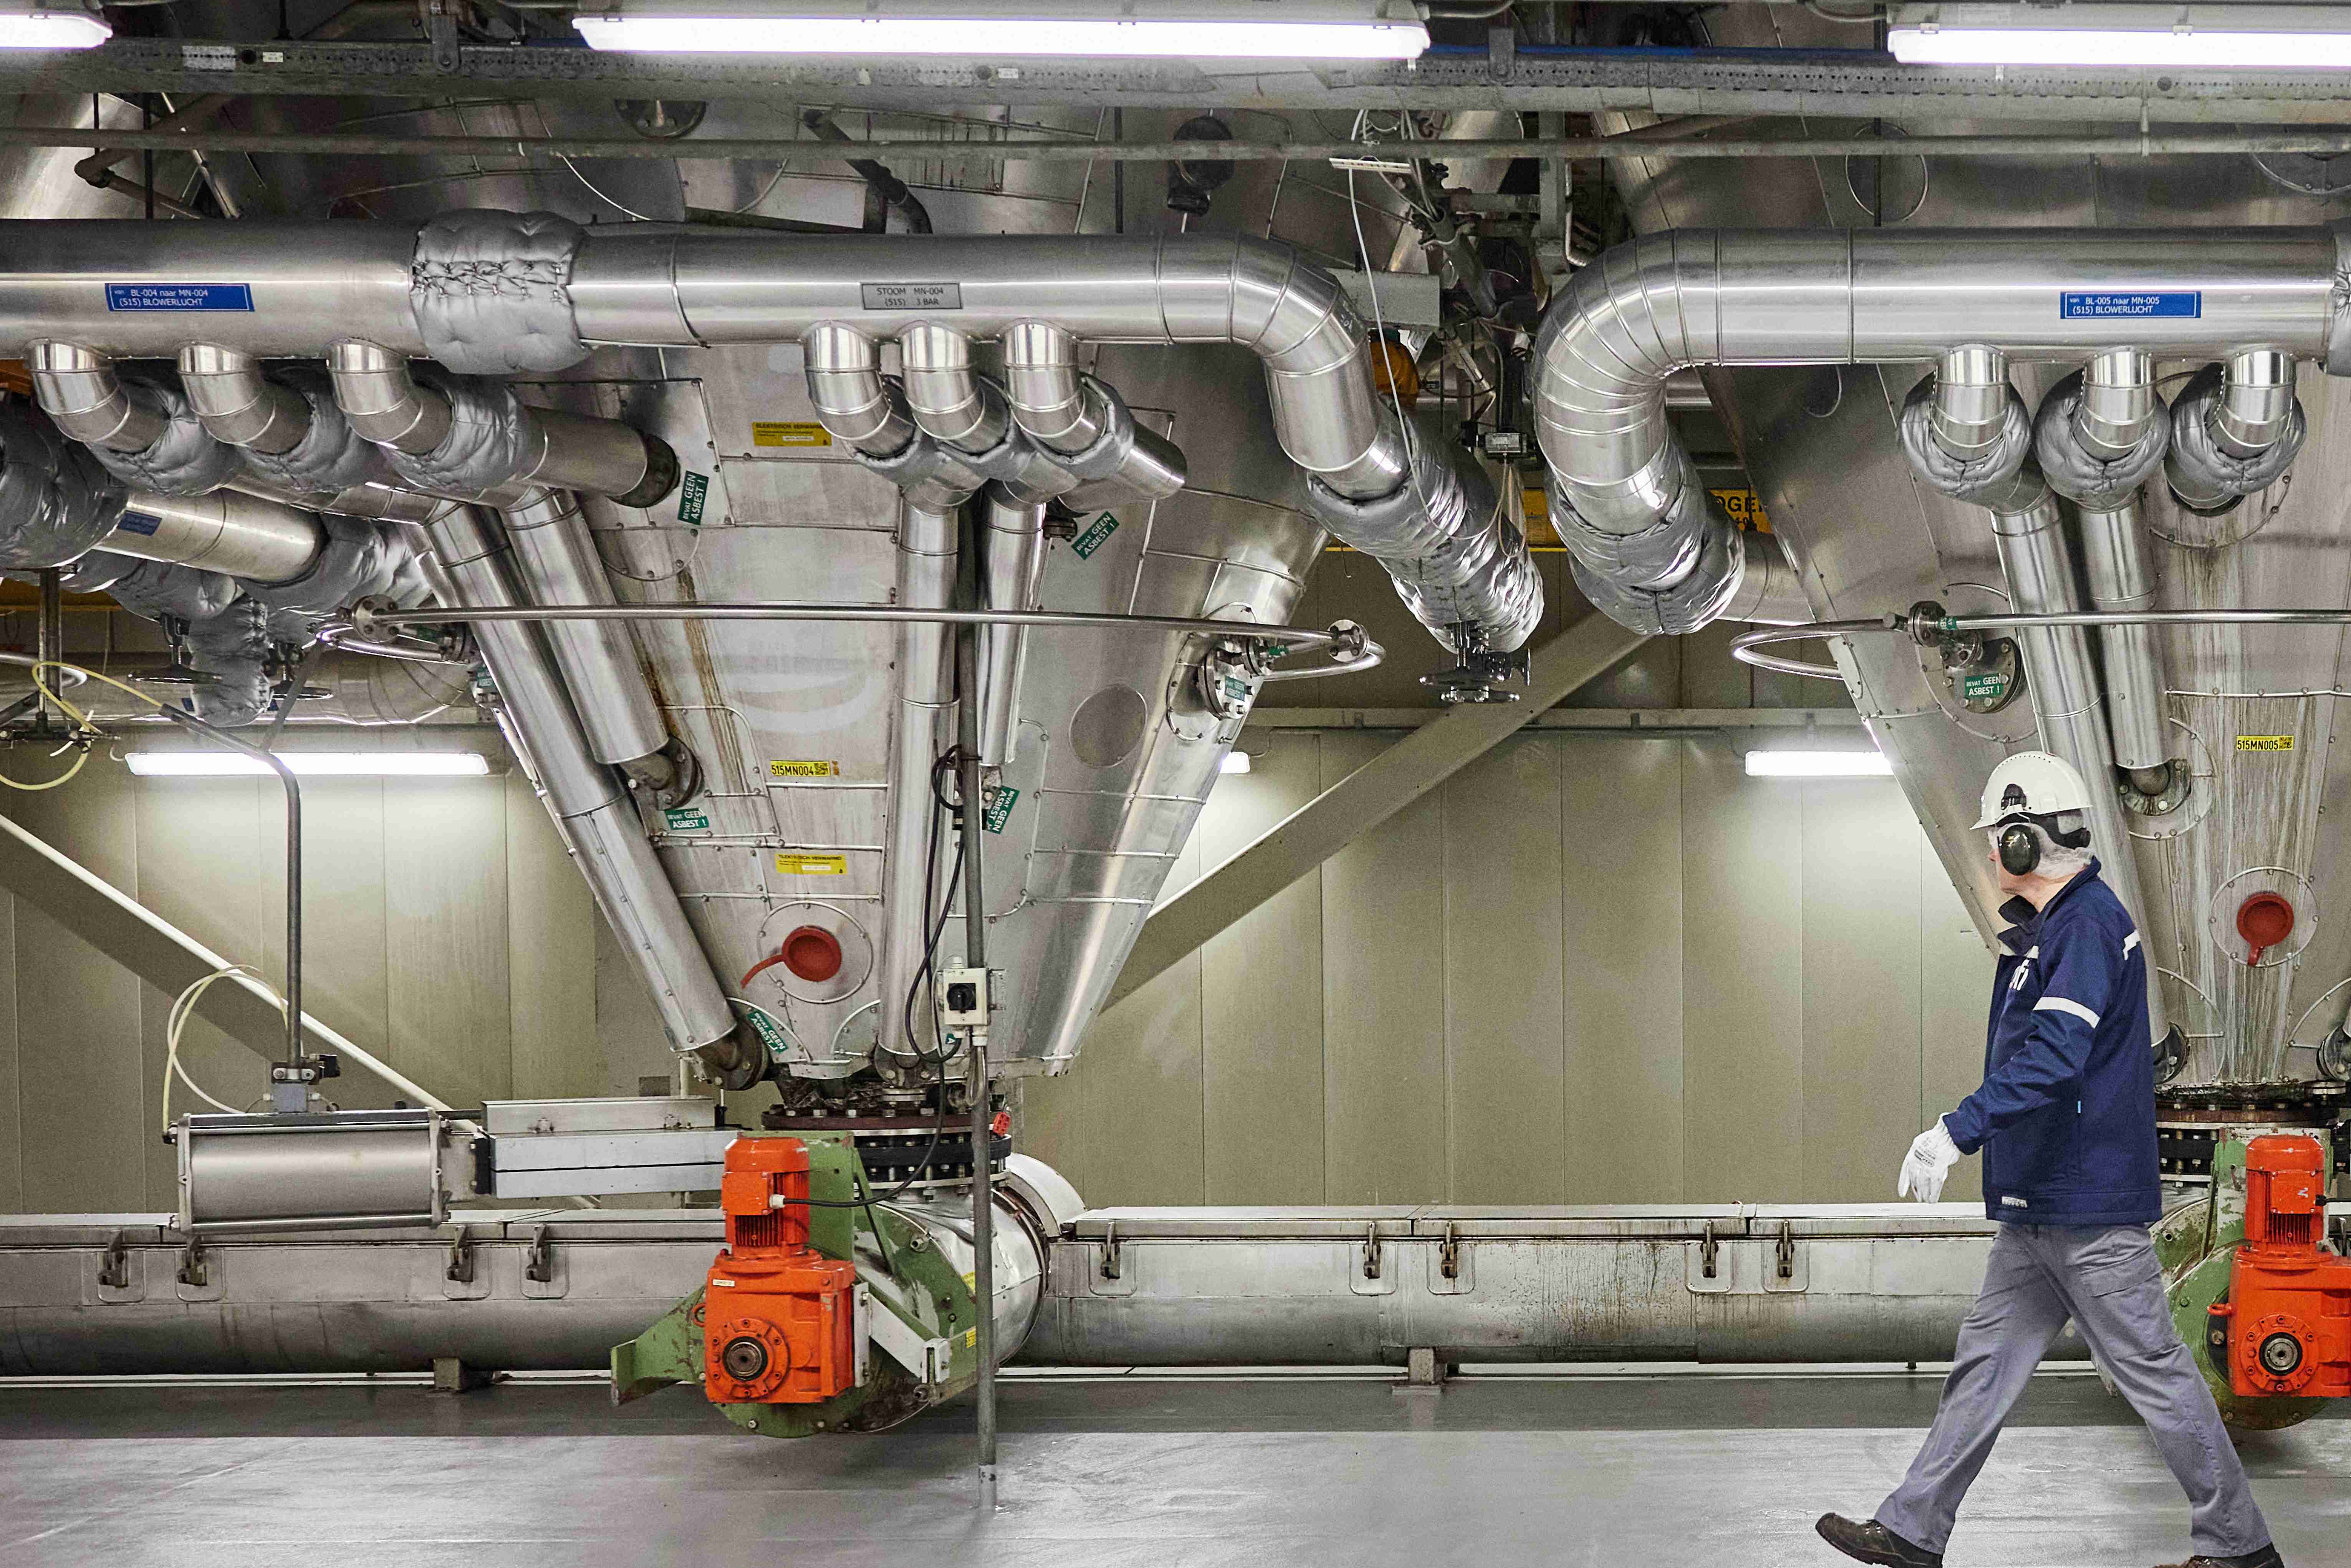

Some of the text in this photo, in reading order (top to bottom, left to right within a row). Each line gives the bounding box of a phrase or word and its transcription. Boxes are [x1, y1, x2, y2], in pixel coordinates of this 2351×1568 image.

[178, 289, 208, 297] MN-004
[877, 287, 944, 295] STOOM MN-004
[119, 298, 203, 306] (515) BLOWERLUCHT
[884, 298, 906, 306] (515)
[2086, 296, 2111, 305] BL-005
[2131, 296, 2160, 305] MN-005
[2073, 305, 2153, 315] (515) BLOWERLUCHT
[684, 474, 696, 498] GEEN
[691, 486, 704, 519] ASBEST
[1092, 515, 1111, 535] GEEN
[1084, 528, 1109, 555] ASBEST
[1983, 675, 2001, 685] GEEN
[1969, 686, 1994, 695] ASBEST
[2237, 740, 2278, 750] 515MN005
[771, 765, 814, 776] 515MN004
[989, 790, 1007, 821] ASBEST
[684, 808, 705, 818] GEEN
[673, 819, 699, 828] ASBEST
[992, 810, 1007, 831] GEEN
[750, 1018, 774, 1044] ASBEST
[768, 1030, 786, 1049] GEEN
